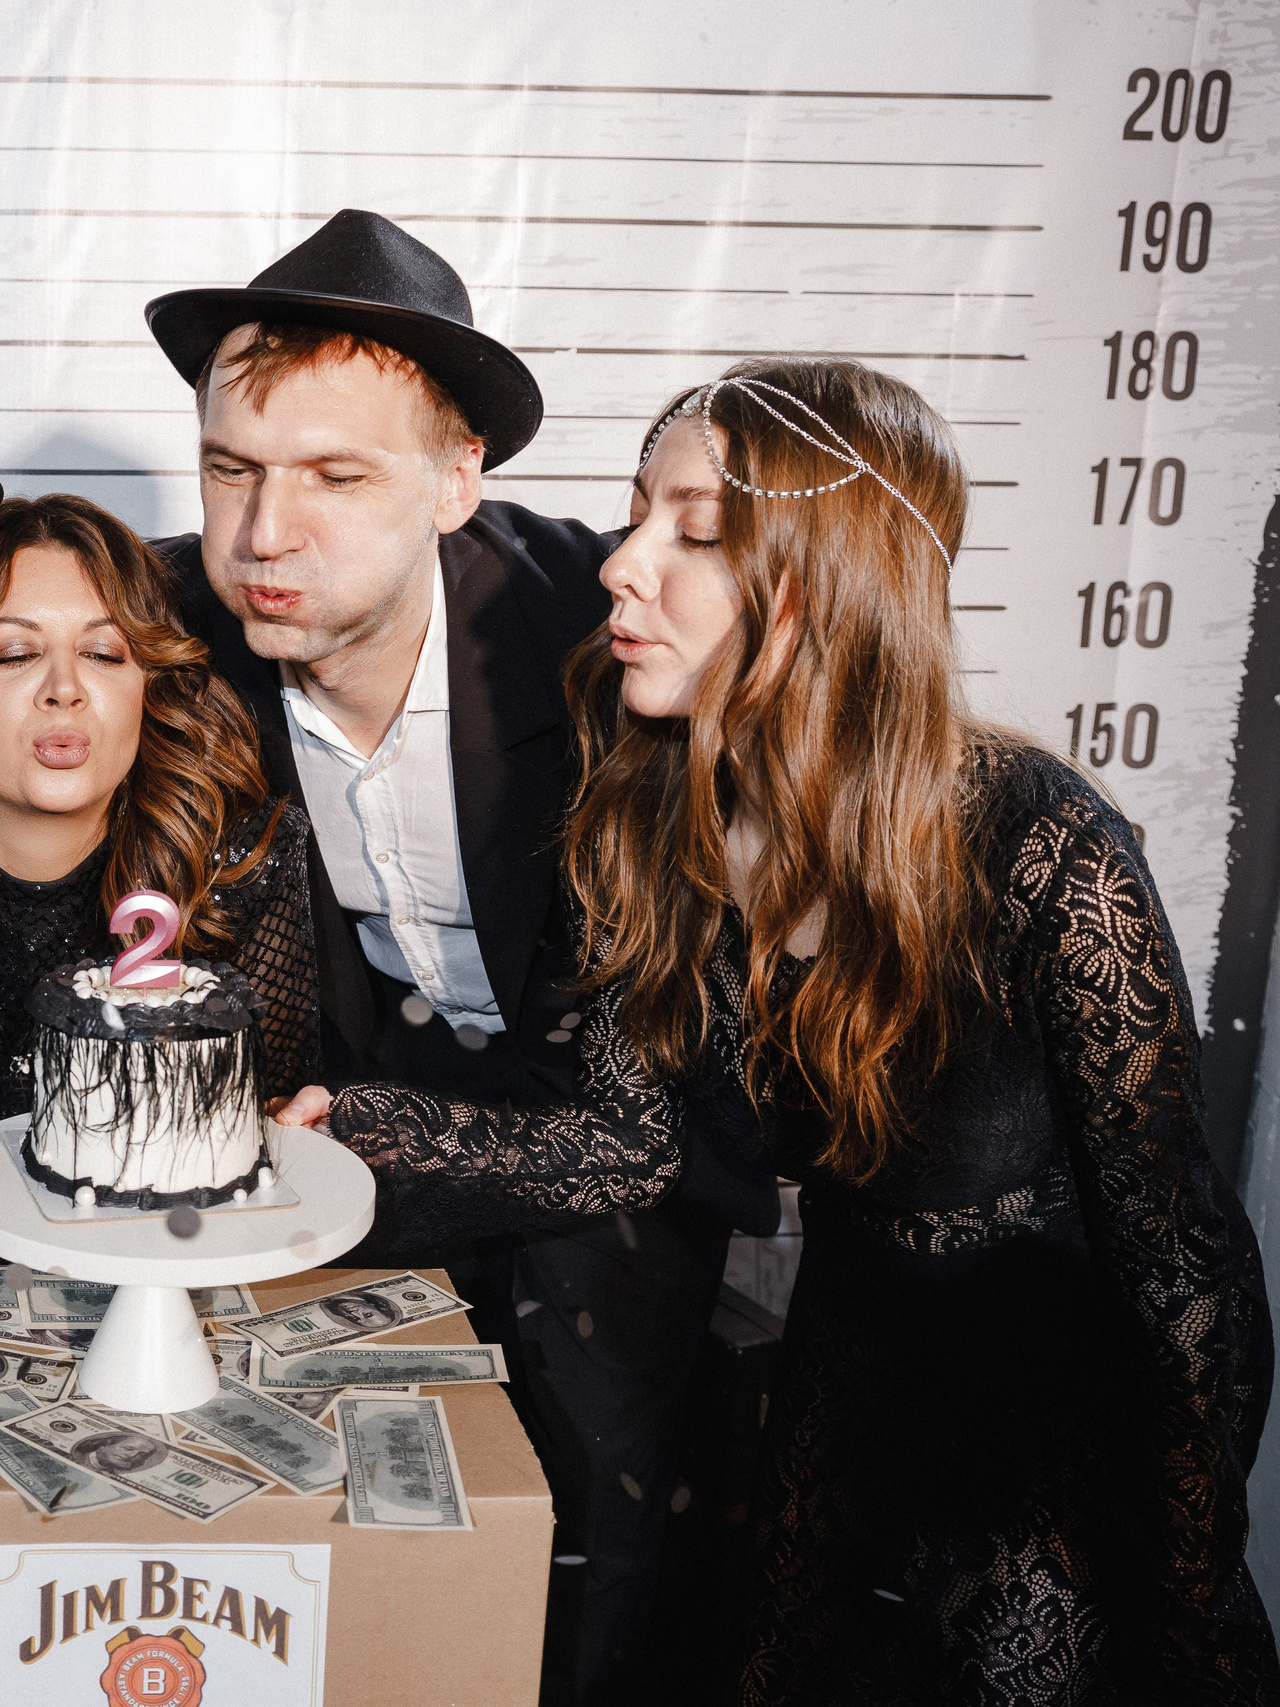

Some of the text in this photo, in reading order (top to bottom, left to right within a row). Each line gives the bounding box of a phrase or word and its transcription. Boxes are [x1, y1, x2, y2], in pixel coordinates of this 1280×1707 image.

[1123, 67, 1232, 143] 200
[1117, 200, 1212, 273] 190
[1103, 330, 1199, 401] 180
[1091, 457, 1186, 526] 170
[1078, 580, 1173, 648] 160
[1066, 703, 1159, 769] 150
[109, 889, 180, 988] 2
[19, 1559, 294, 1667] JIM BEAM
[117, 1680, 150, 1707] STANDA
[123, 1649, 185, 1674] BEAM FORMULA
[141, 1667, 166, 1695] B
